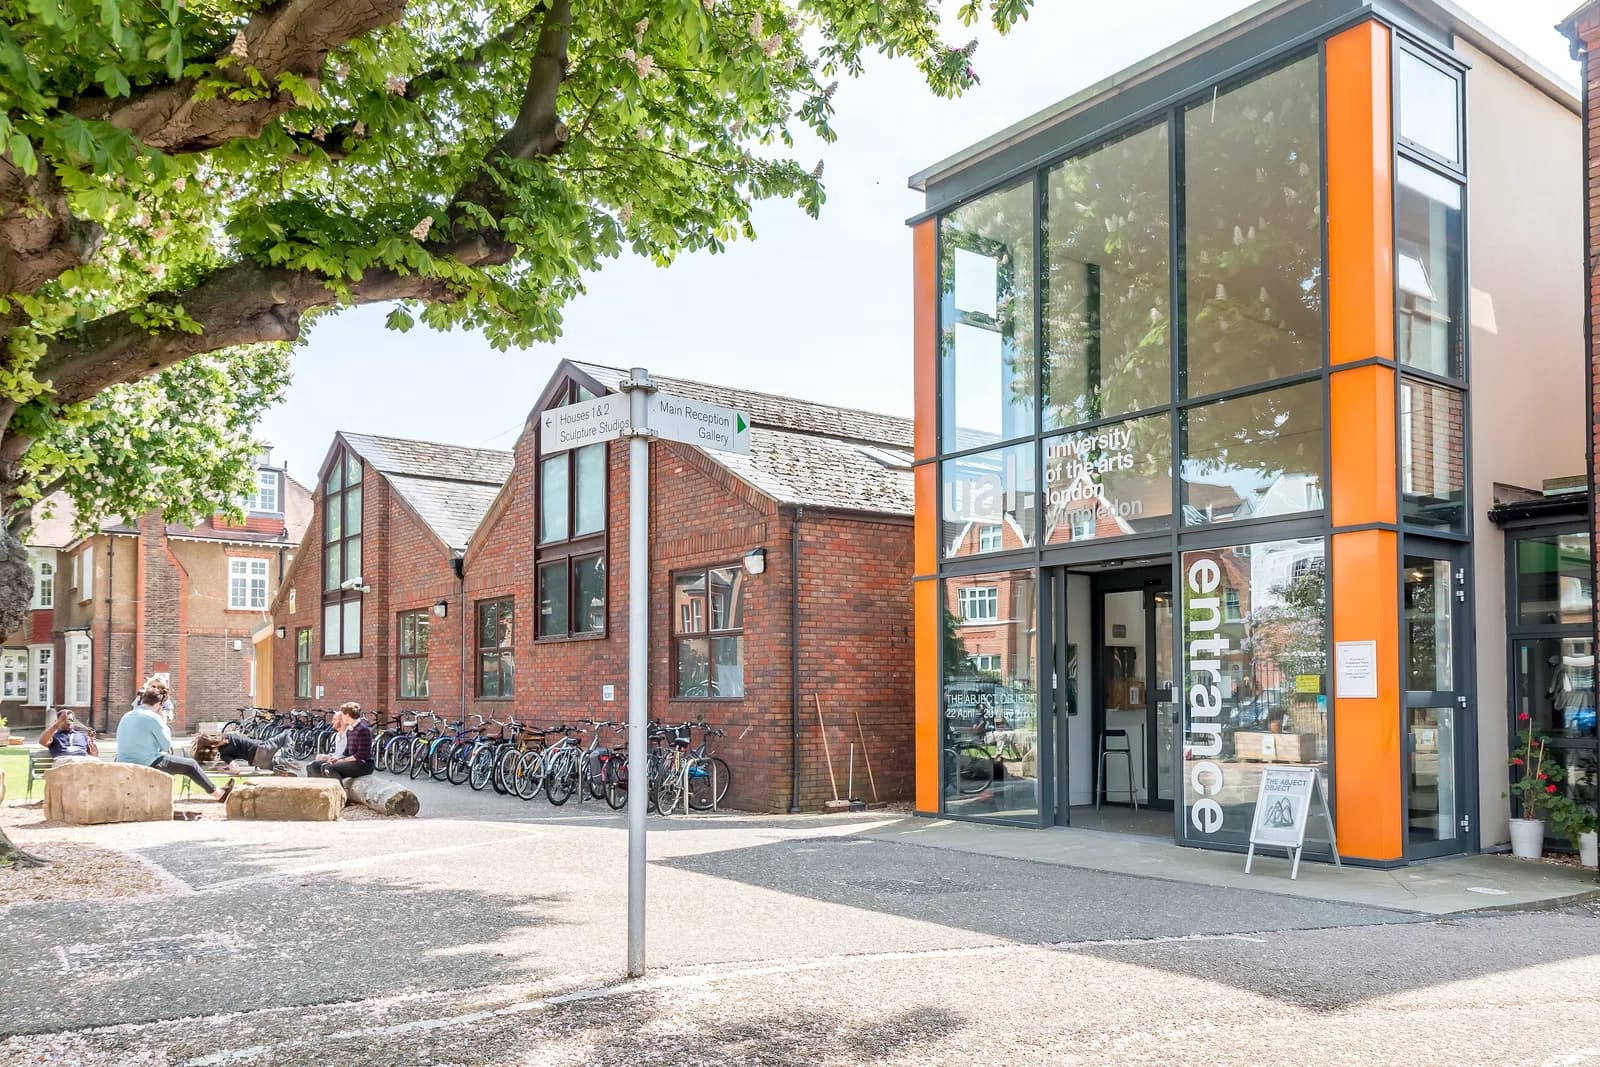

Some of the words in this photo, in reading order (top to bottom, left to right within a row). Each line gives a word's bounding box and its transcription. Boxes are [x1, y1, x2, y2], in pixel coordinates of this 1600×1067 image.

[560, 411, 590, 426] Houses
[660, 401, 683, 417] Main
[685, 405, 730, 427] Reception
[560, 425, 598, 444] Sculpture
[599, 418, 630, 434] Studios
[698, 426, 729, 445] Gallery
[1046, 427, 1132, 459] university
[1046, 463, 1062, 483] of
[1066, 459, 1093, 480] the
[1097, 452, 1134, 474] arts
[1046, 482, 1105, 506] london
[946, 694, 963, 704] THE
[1188, 558, 1230, 834] entrance
[1265, 778, 1279, 786] THE
